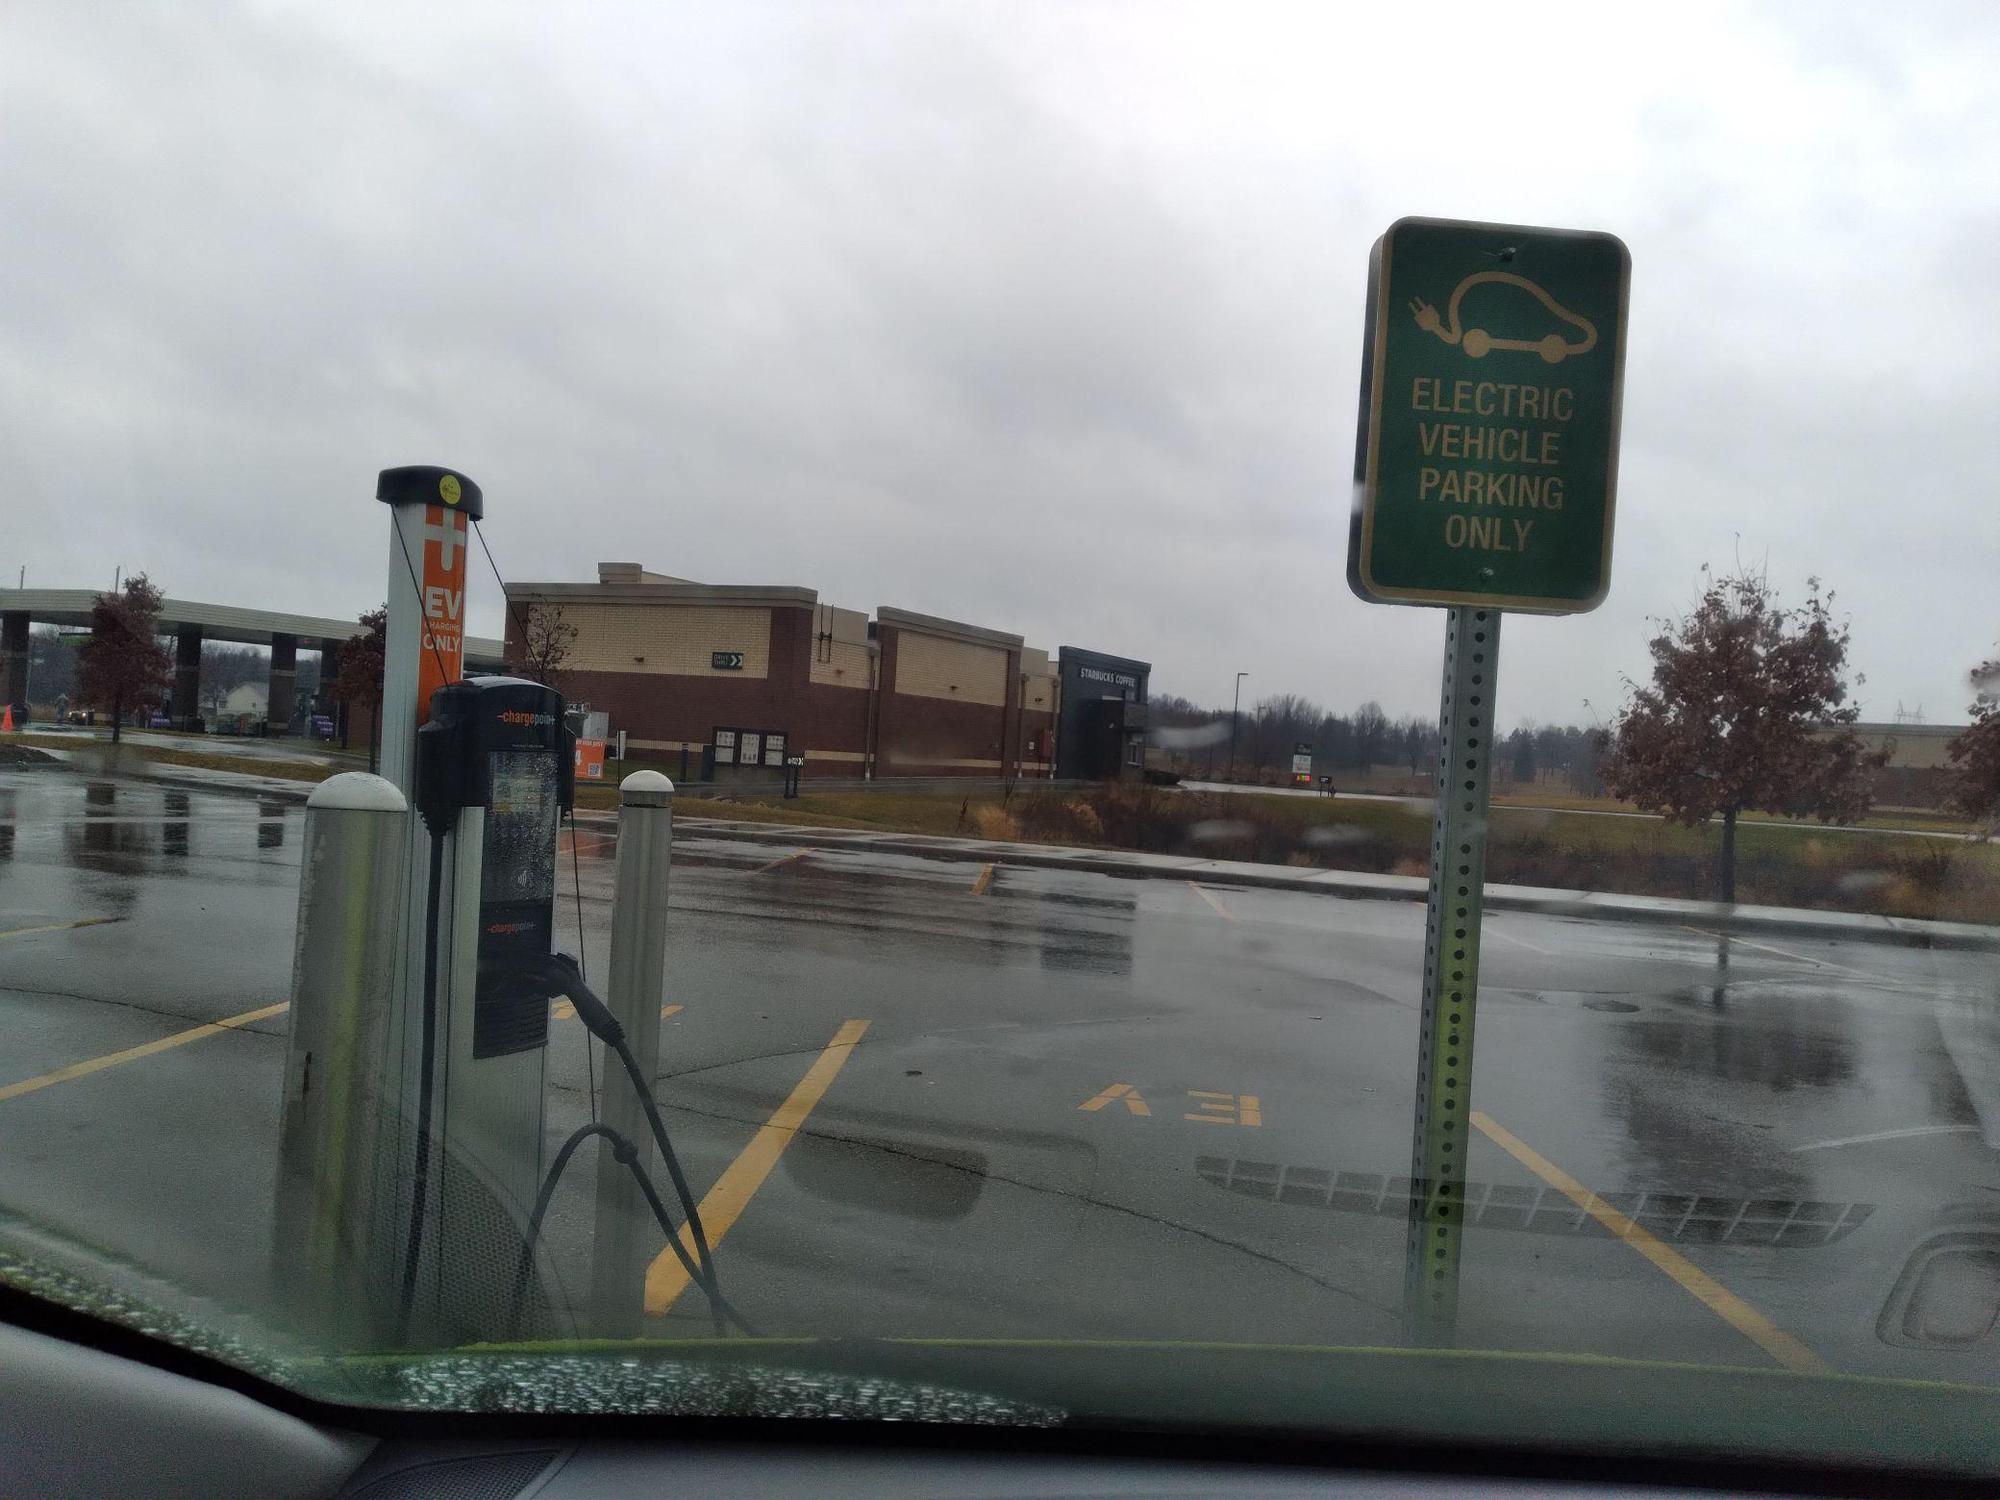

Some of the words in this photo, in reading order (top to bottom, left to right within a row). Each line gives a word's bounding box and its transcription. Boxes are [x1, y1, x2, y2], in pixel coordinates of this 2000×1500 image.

[1411, 377, 1574, 422] ELECTRIC
[1418, 423, 1561, 465] VEHICLE
[1418, 467, 1565, 510] PARKING
[1444, 514, 1536, 552] ONLY
[425, 585, 462, 620] EV
[423, 633, 461, 652] ONLY
[1080, 667, 1114, 683] STARBUCKS
[1115, 674, 1136, 688] COFFEE
[1077, 1083, 1262, 1127] EV
